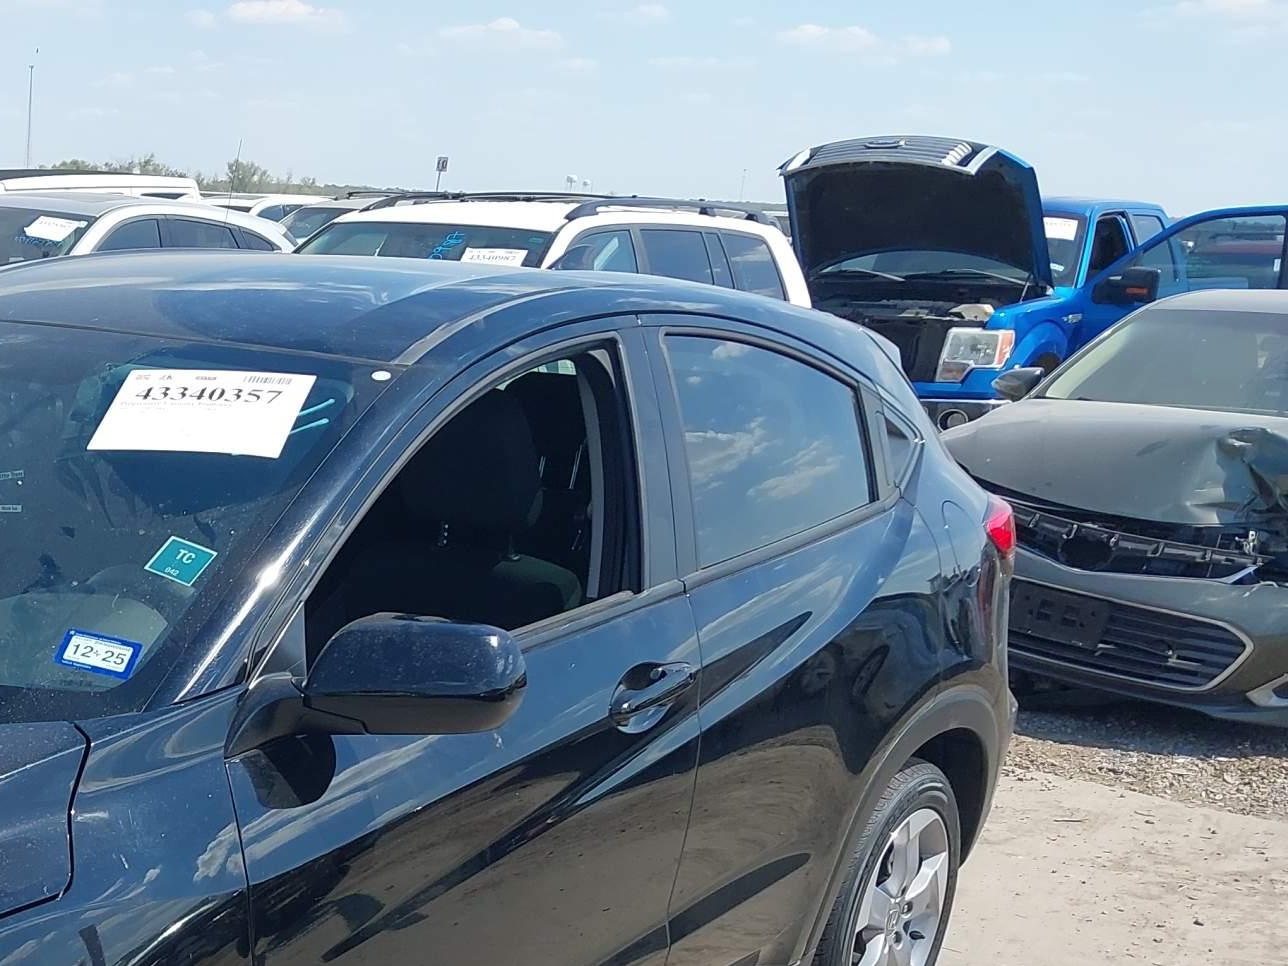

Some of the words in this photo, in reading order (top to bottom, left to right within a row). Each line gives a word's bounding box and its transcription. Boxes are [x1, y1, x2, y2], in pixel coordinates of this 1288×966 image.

[135, 385, 284, 404] 43340357
[175, 548, 196, 564] TC
[73, 643, 94, 658] 12
[101, 650, 127, 666] 25
